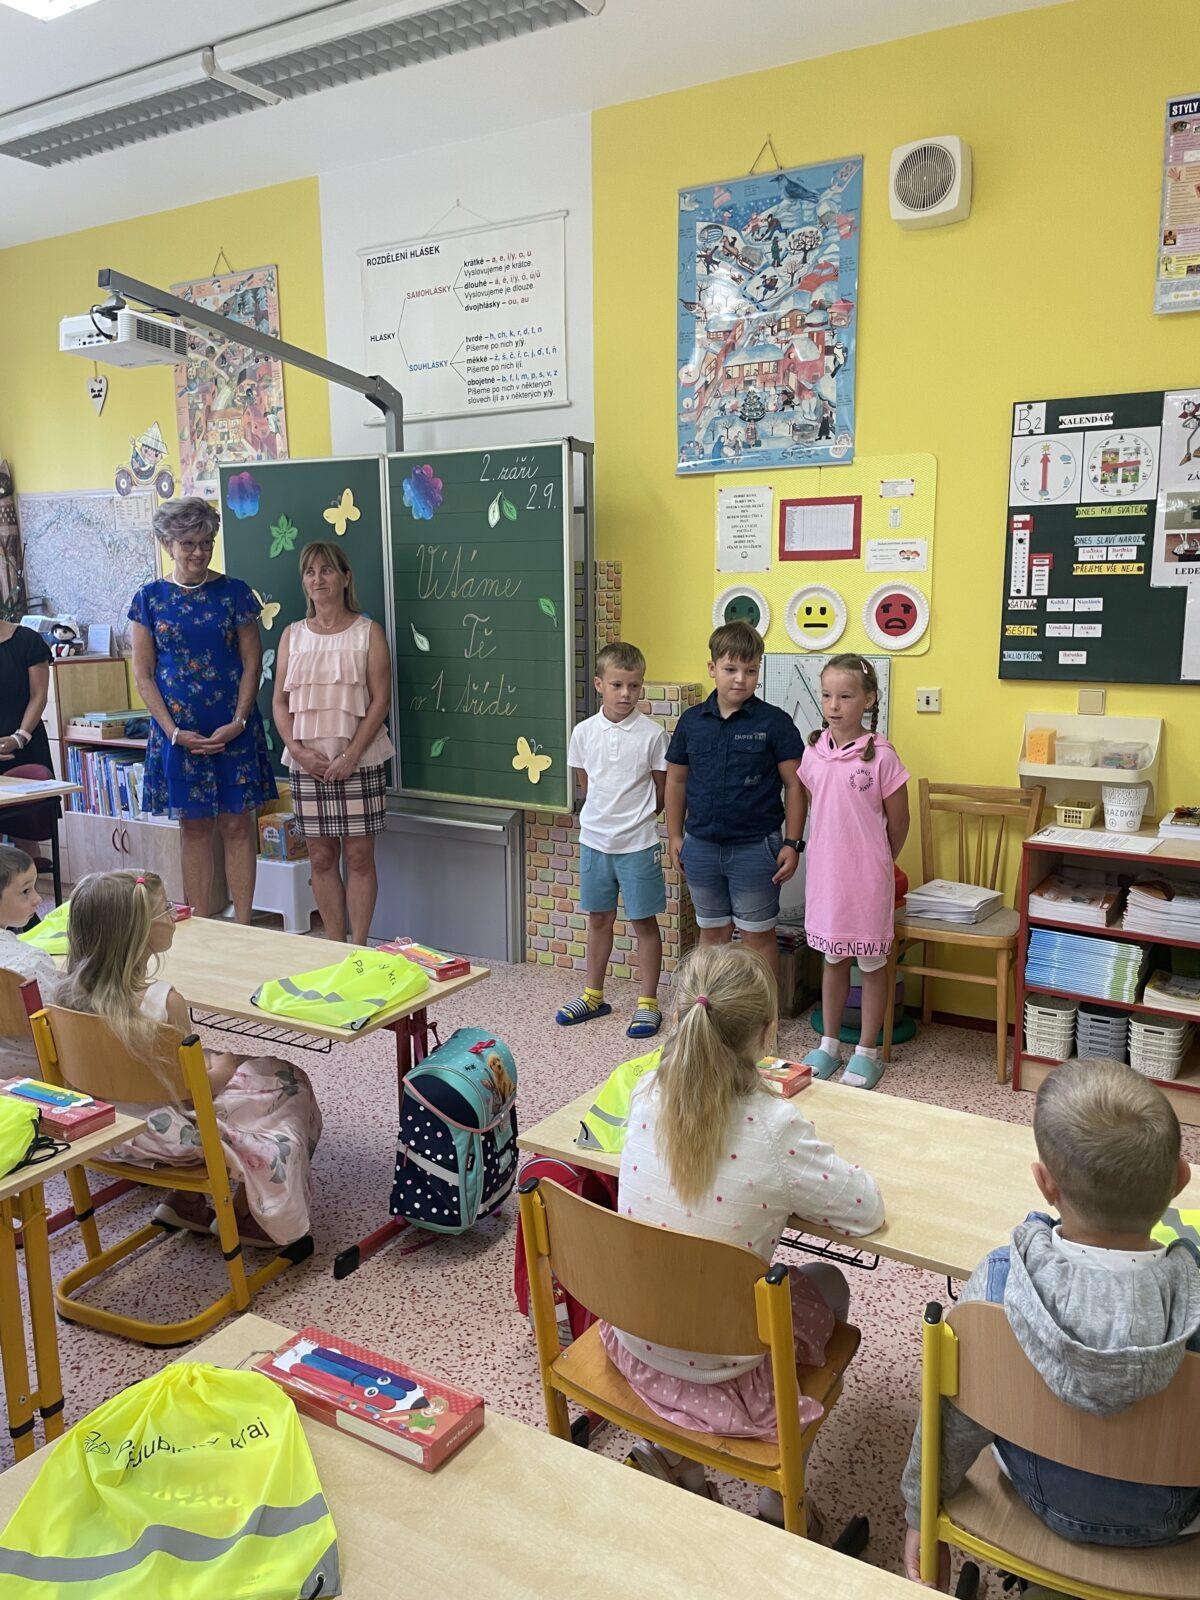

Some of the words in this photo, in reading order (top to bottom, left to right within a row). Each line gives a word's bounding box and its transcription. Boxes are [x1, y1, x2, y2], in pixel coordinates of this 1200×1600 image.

[1172, 102, 1198, 115] STYLY
[367, 249, 408, 266] ROZDĚLENÍ
[410, 246, 440, 258] HLÁSEK
[464, 258, 484, 267] krátké
[464, 265, 502, 278] Vyslovujeme
[504, 263, 510, 272] je
[464, 280, 487, 289] dlouhé
[407, 285, 451, 299] SAMOHLÁSKY
[464, 287, 503, 300] Vyslovujeme
[505, 287, 510, 295] je
[465, 301, 500, 311] dvojhlásky
[370, 332, 395, 342] HLÁSKY
[409, 360, 448, 371] SOUHLÁSKY
[467, 376, 495, 386] obojetné
[521, 380, 551, 388] některých
[1060, 414, 1111, 426] KALENDÁŘ
[480, 454, 494, 481] 2.
[497, 456, 539, 480] září
[1078, 508, 1095, 516] DNES
[1100, 506, 1113, 514] MÁ
[1117, 505, 1144, 514] SVÁTEK
[1096, 535, 1117, 544] SLAVÍ
[416, 544, 522, 599] Vítáme
[1075, 564, 1102, 573] PŘEJEME
[1106, 563, 1116, 572] VŠE
[1010, 599, 1034, 609] ŠATNA
[462, 613, 497, 659] Tě
[431, 670, 446, 712] 1.
[455, 672, 518, 716] třídě
